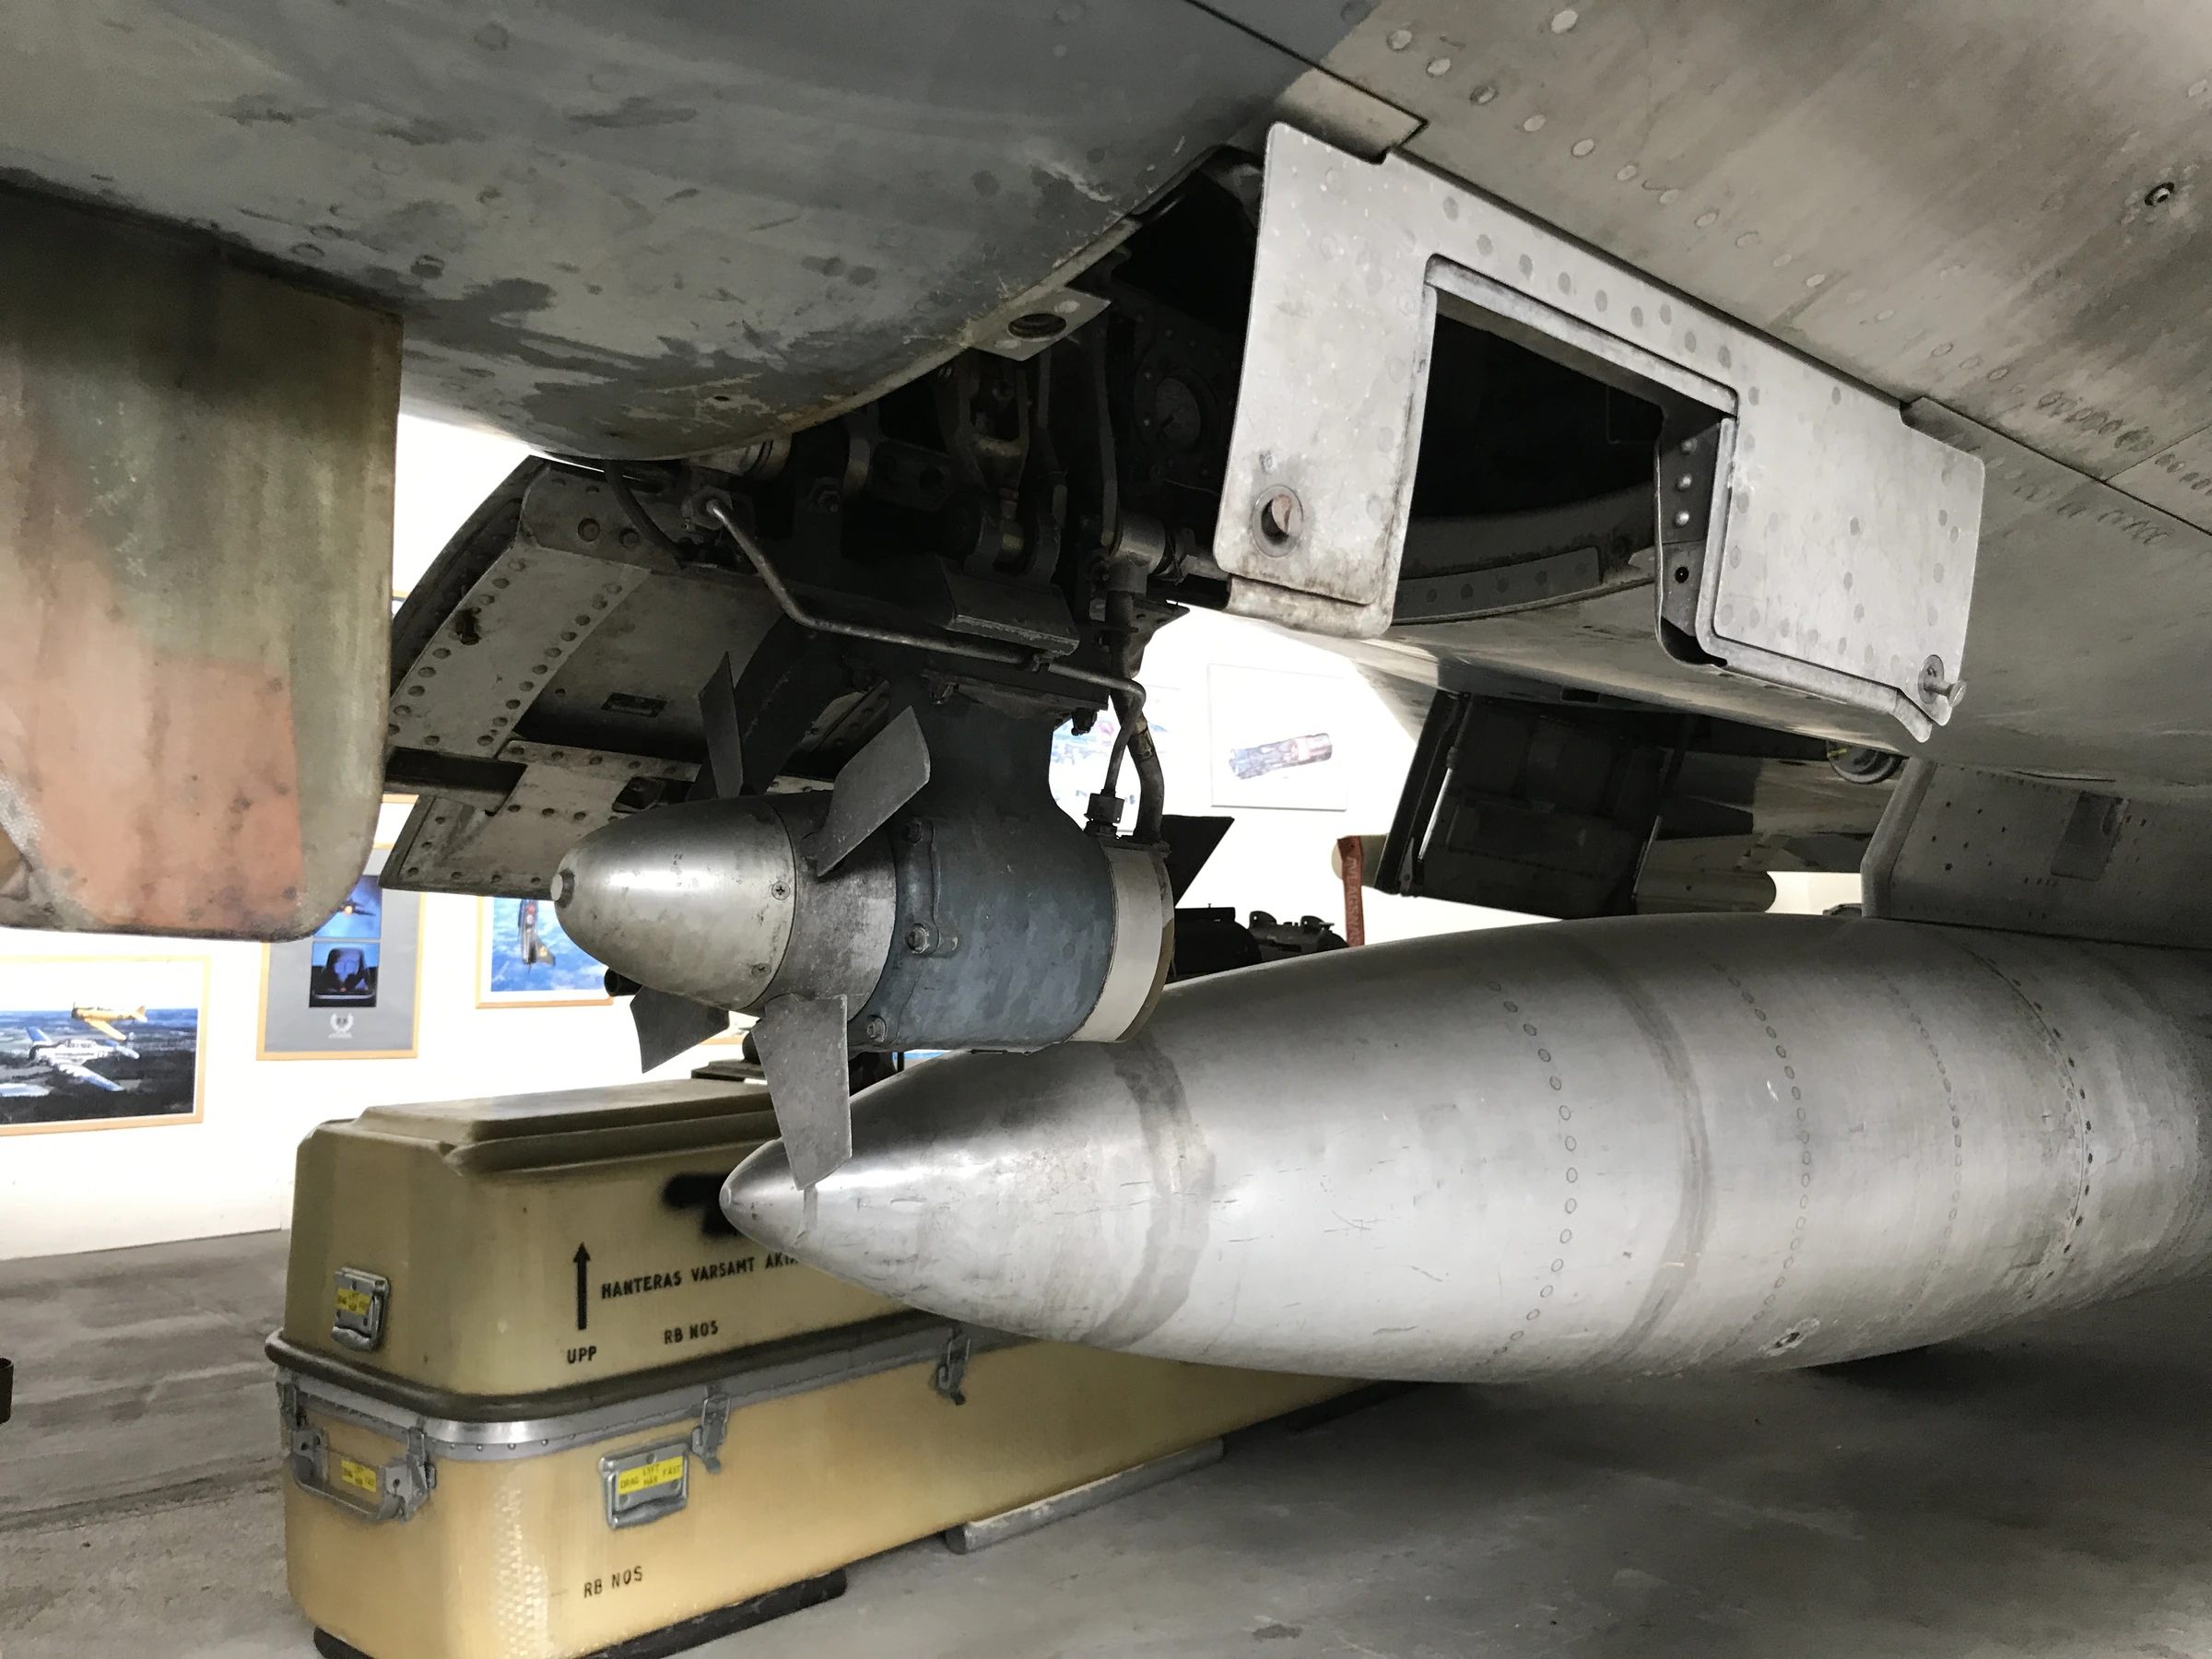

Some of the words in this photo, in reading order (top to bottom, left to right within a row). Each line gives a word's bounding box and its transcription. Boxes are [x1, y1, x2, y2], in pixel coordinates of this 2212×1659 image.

[601, 1271, 682, 1300] HANTERAS
[690, 1256, 755, 1282] VARSAMT
[664, 1326, 683, 1345] RB
[567, 1345, 597, 1364] UPP
[582, 1578, 603, 1599] RB
